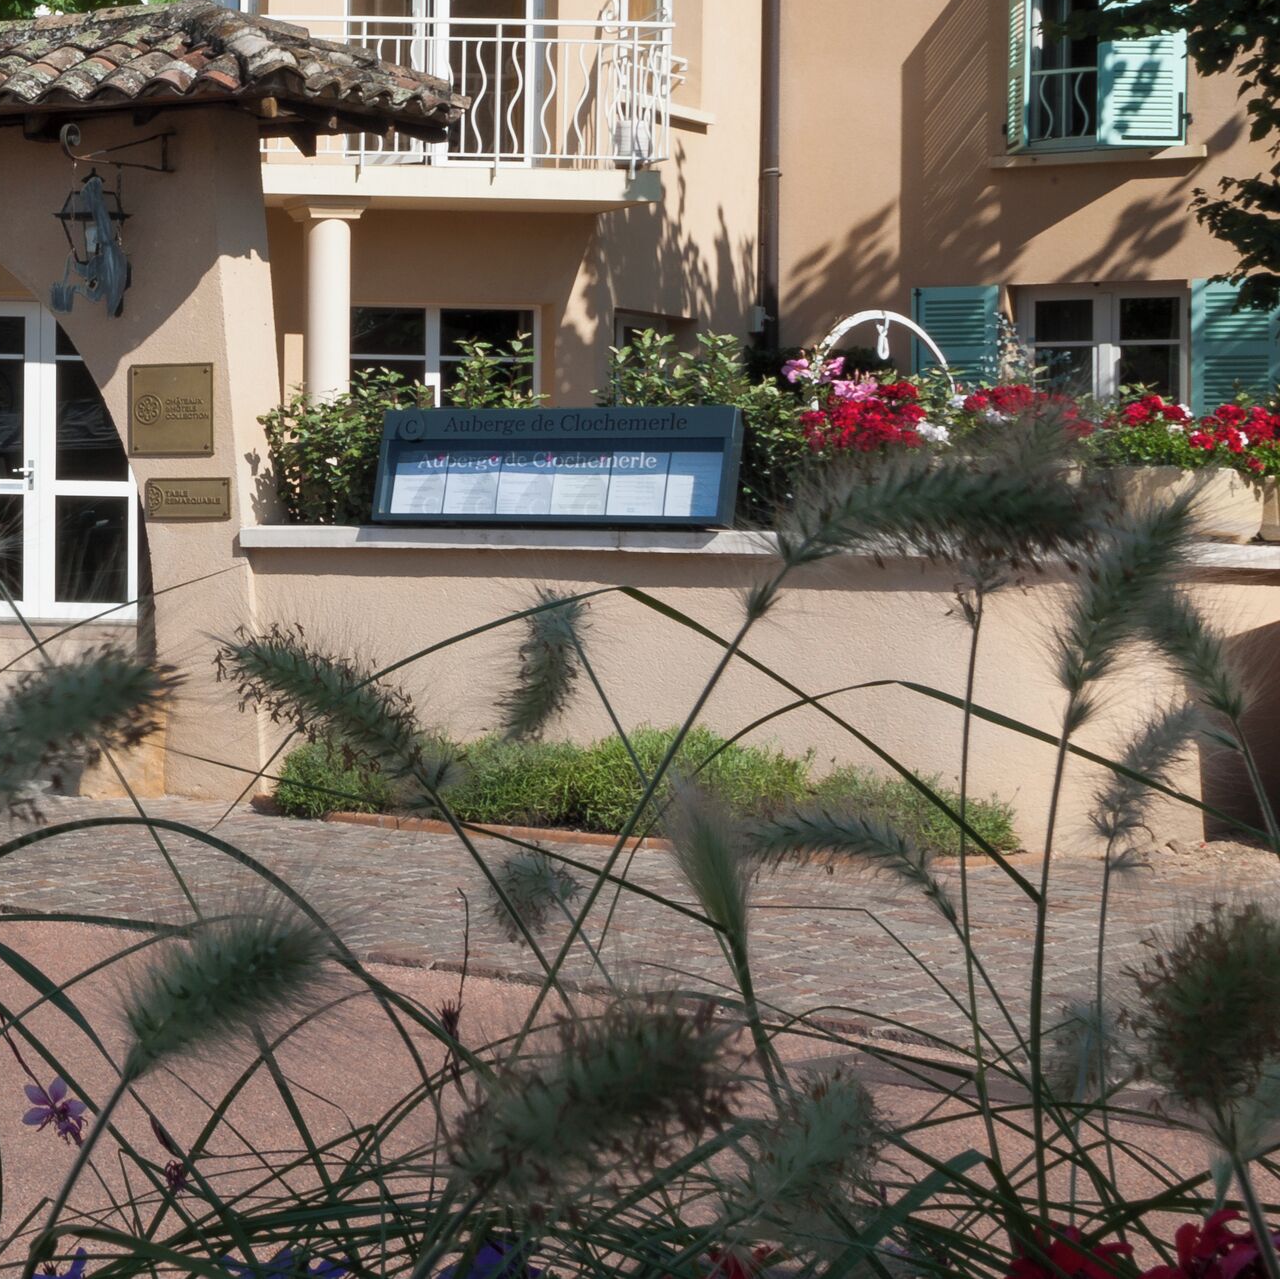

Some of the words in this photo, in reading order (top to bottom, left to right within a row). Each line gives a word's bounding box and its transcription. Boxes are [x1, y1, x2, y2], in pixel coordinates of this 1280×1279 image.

[444, 415, 524, 435] Auberge
[531, 414, 555, 432] de
[560, 412, 688, 432] Clochemerle
